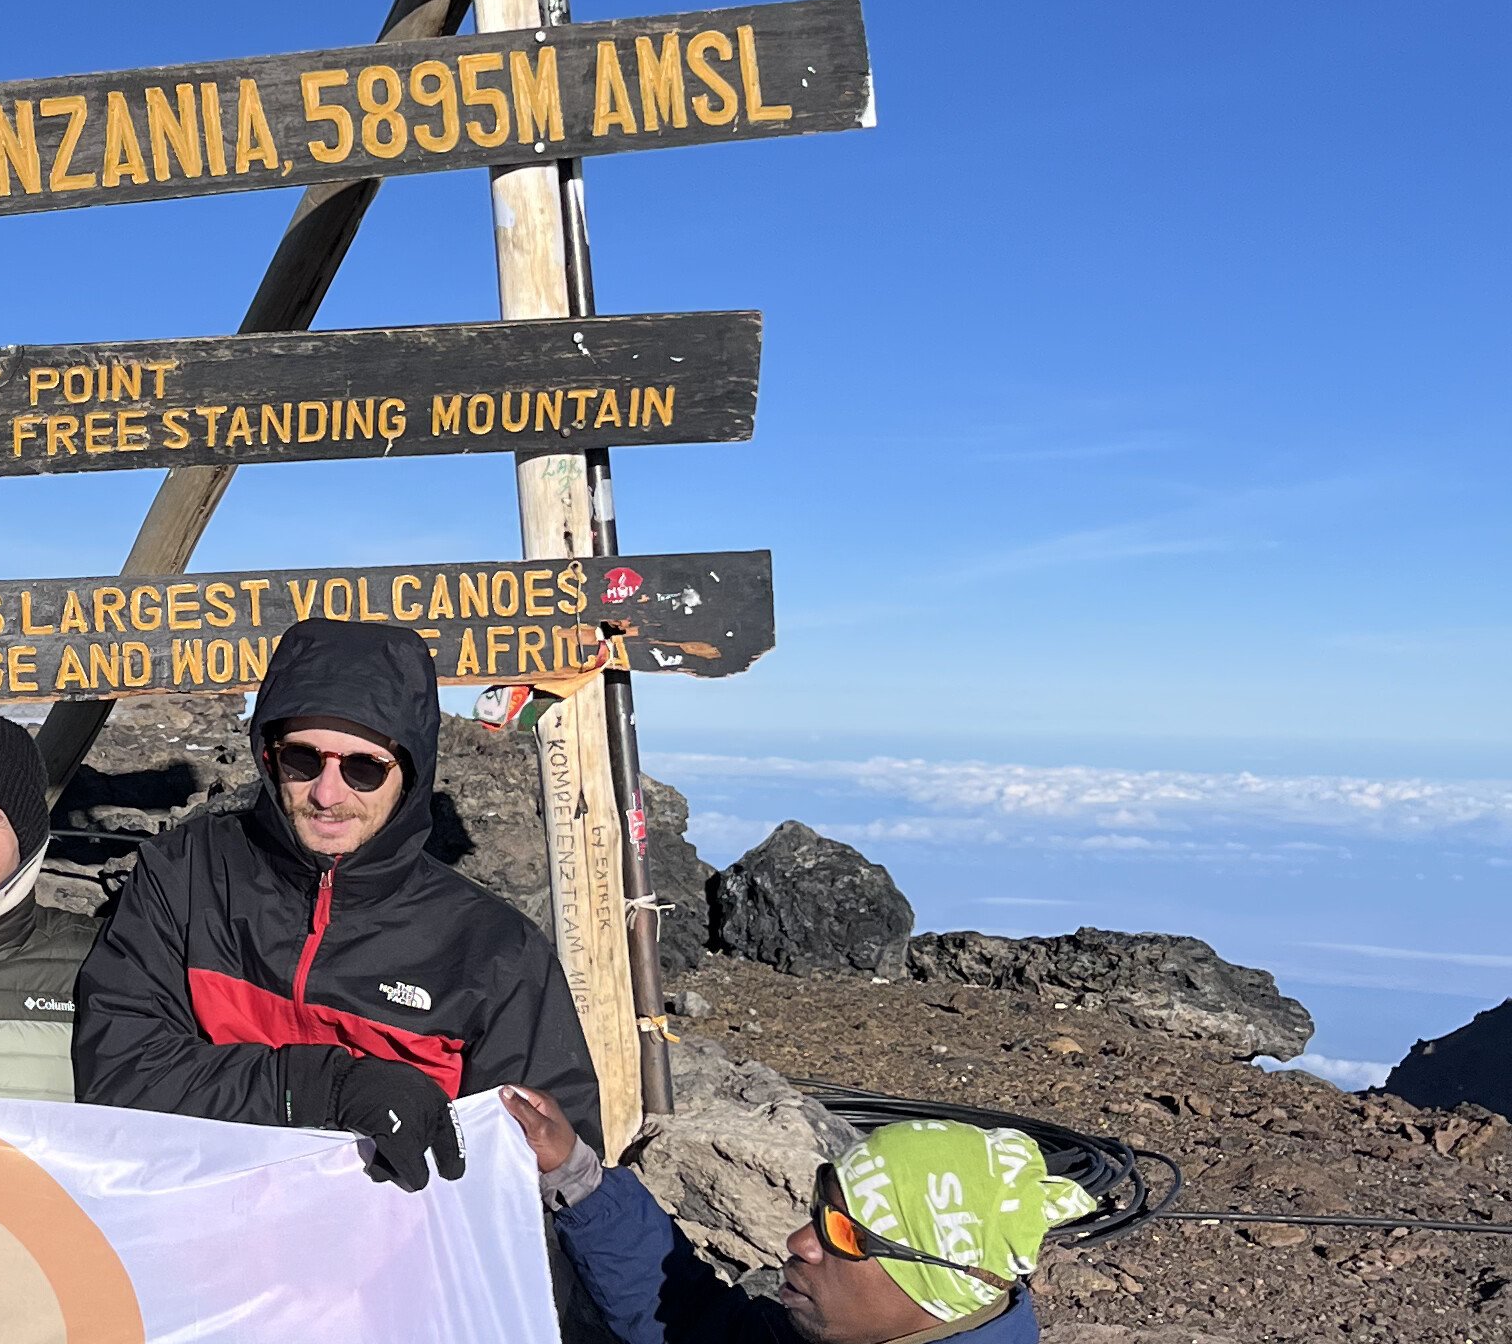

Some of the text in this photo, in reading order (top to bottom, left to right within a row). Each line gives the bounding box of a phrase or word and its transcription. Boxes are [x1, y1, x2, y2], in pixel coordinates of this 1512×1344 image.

[300, 45, 565, 164] 5895M
[592, 24, 793, 137] AMSL
[29, 360, 178, 407] POINT
[431, 385, 676, 437] MOUNTAIN
[21, 578, 270, 637] LARGEST
[287, 569, 587, 623] VOLCANOES
[55, 641, 151, 691] AND
[171, 635, 284, 686] WON
[36, 997, 76, 1012] Columb
